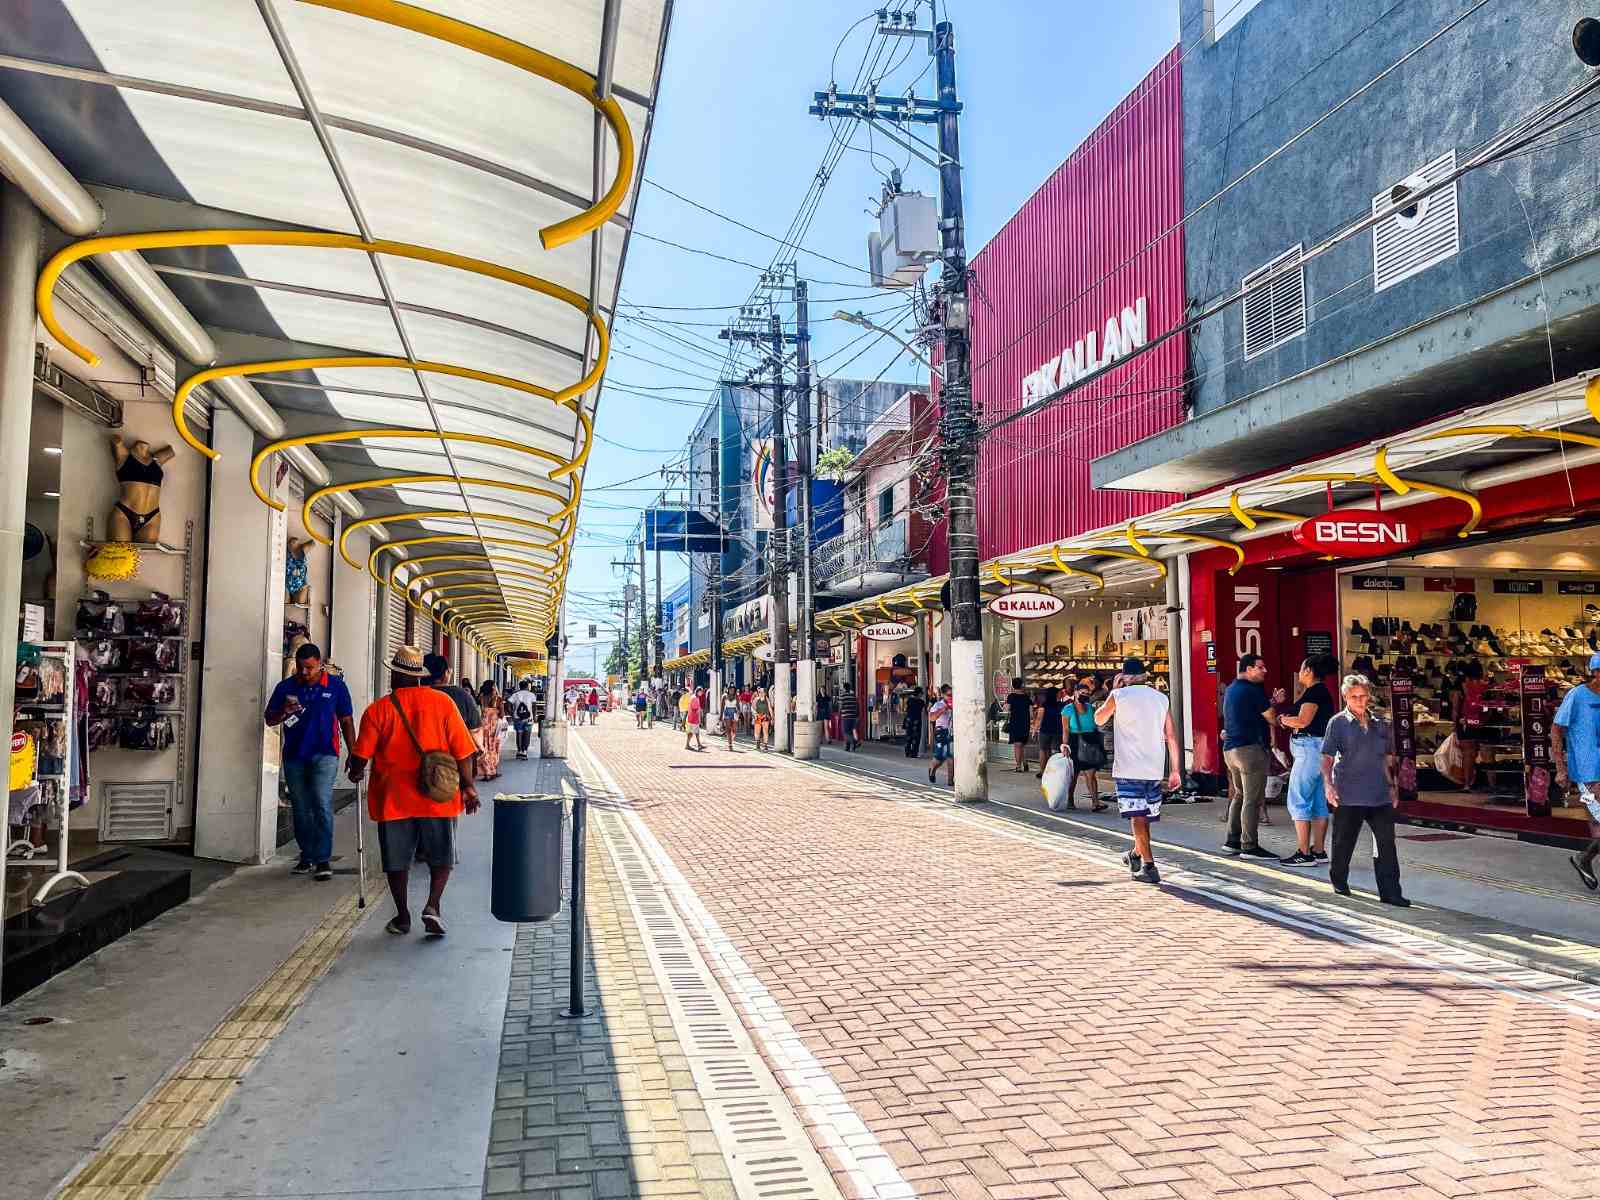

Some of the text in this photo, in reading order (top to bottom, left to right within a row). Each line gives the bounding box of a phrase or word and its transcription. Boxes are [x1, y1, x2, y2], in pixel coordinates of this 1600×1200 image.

[1041, 297, 1148, 391] KALLAN
[1315, 521, 1408, 543] BESNI
[1010, 601, 1055, 611] KALLAN
[875, 627, 908, 636] KALLAN
